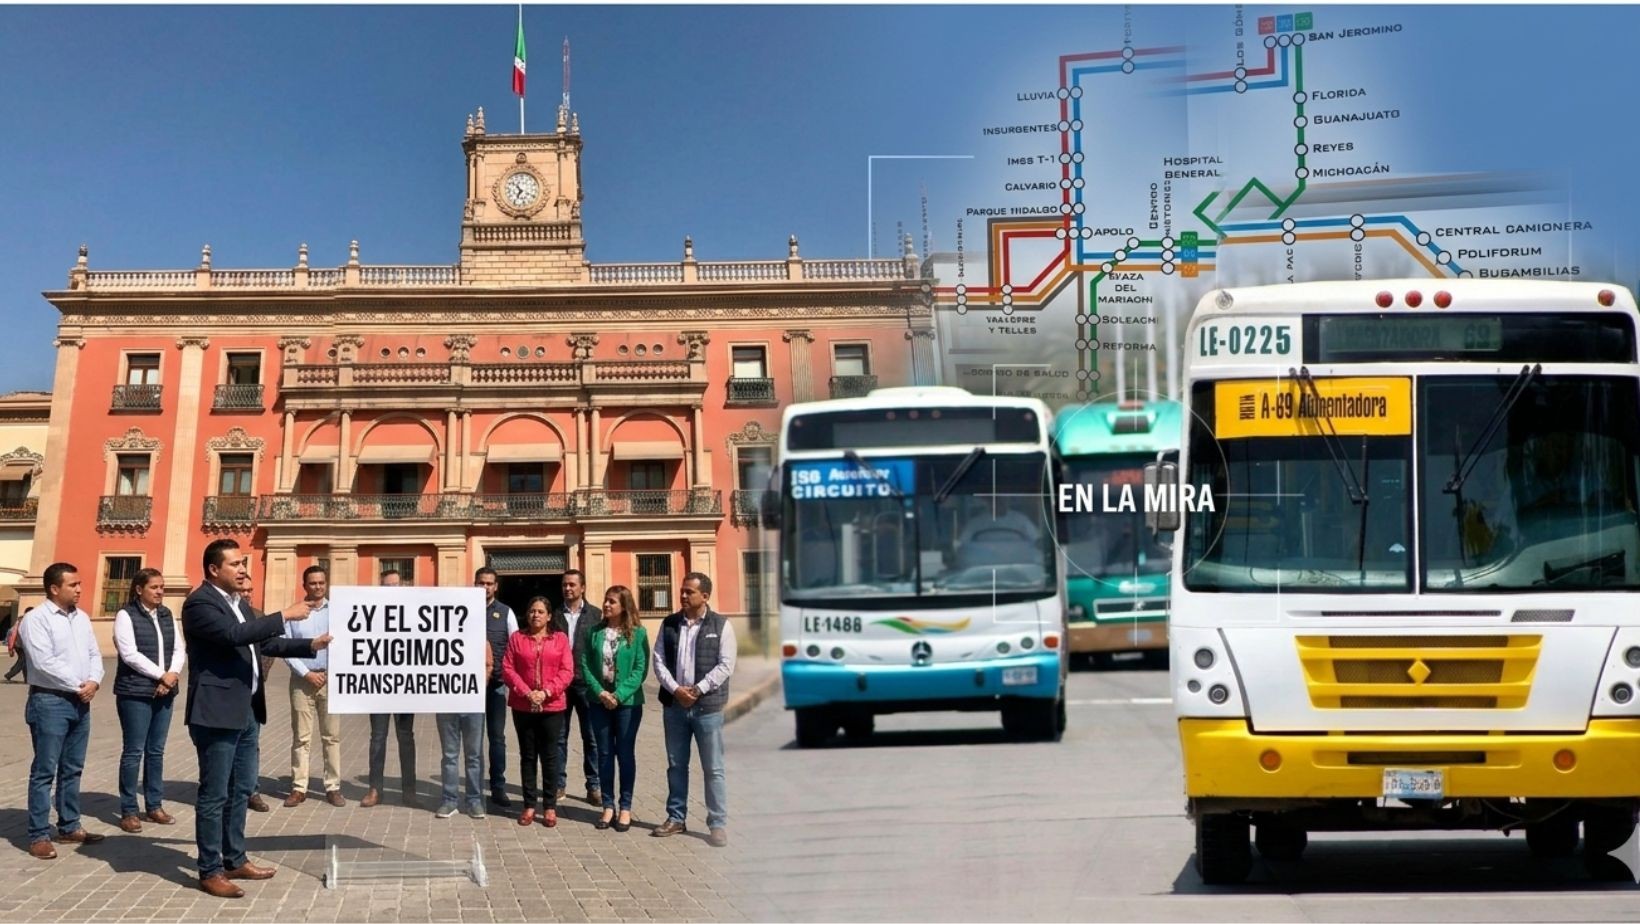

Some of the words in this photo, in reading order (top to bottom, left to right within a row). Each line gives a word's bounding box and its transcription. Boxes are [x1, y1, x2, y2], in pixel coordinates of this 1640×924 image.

[1308, 31, 1334, 42] SAN
[1017, 91, 1055, 102] LLUVIA
[1312, 87, 1367, 101] FLORIDA
[1313, 109, 1401, 125] GUANAJUATO
[1313, 142, 1354, 153] REYES
[1007, 155, 1034, 166] IMSS
[1037, 154, 1055, 164] T-1
[1164, 156, 1223, 167] HOSPITAL
[1313, 161, 1390, 178] MICHOACÁN
[1005, 181, 1057, 192] CALVARIO
[966, 207, 1007, 217] PARQUE
[1093, 227, 1135, 237] APOLO
[1435, 225, 1501, 238] CENTRAL
[1505, 221, 1593, 235] CAMIONERA
[1458, 246, 1542, 259] POLIFORUM
[1114, 283, 1137, 292] DEL
[998, 326, 1037, 335] TELLES
[1200, 325, 1291, 357] LE-0225
[791, 483, 891, 499] CIRCUITO
[347, 604, 377, 633] ¿Y
[384, 604, 412, 633] EL
[417, 604, 469, 633] SIT?
[351, 638, 465, 667] EXIGIMOS
[335, 673, 479, 695] TRANSPARENCIA
